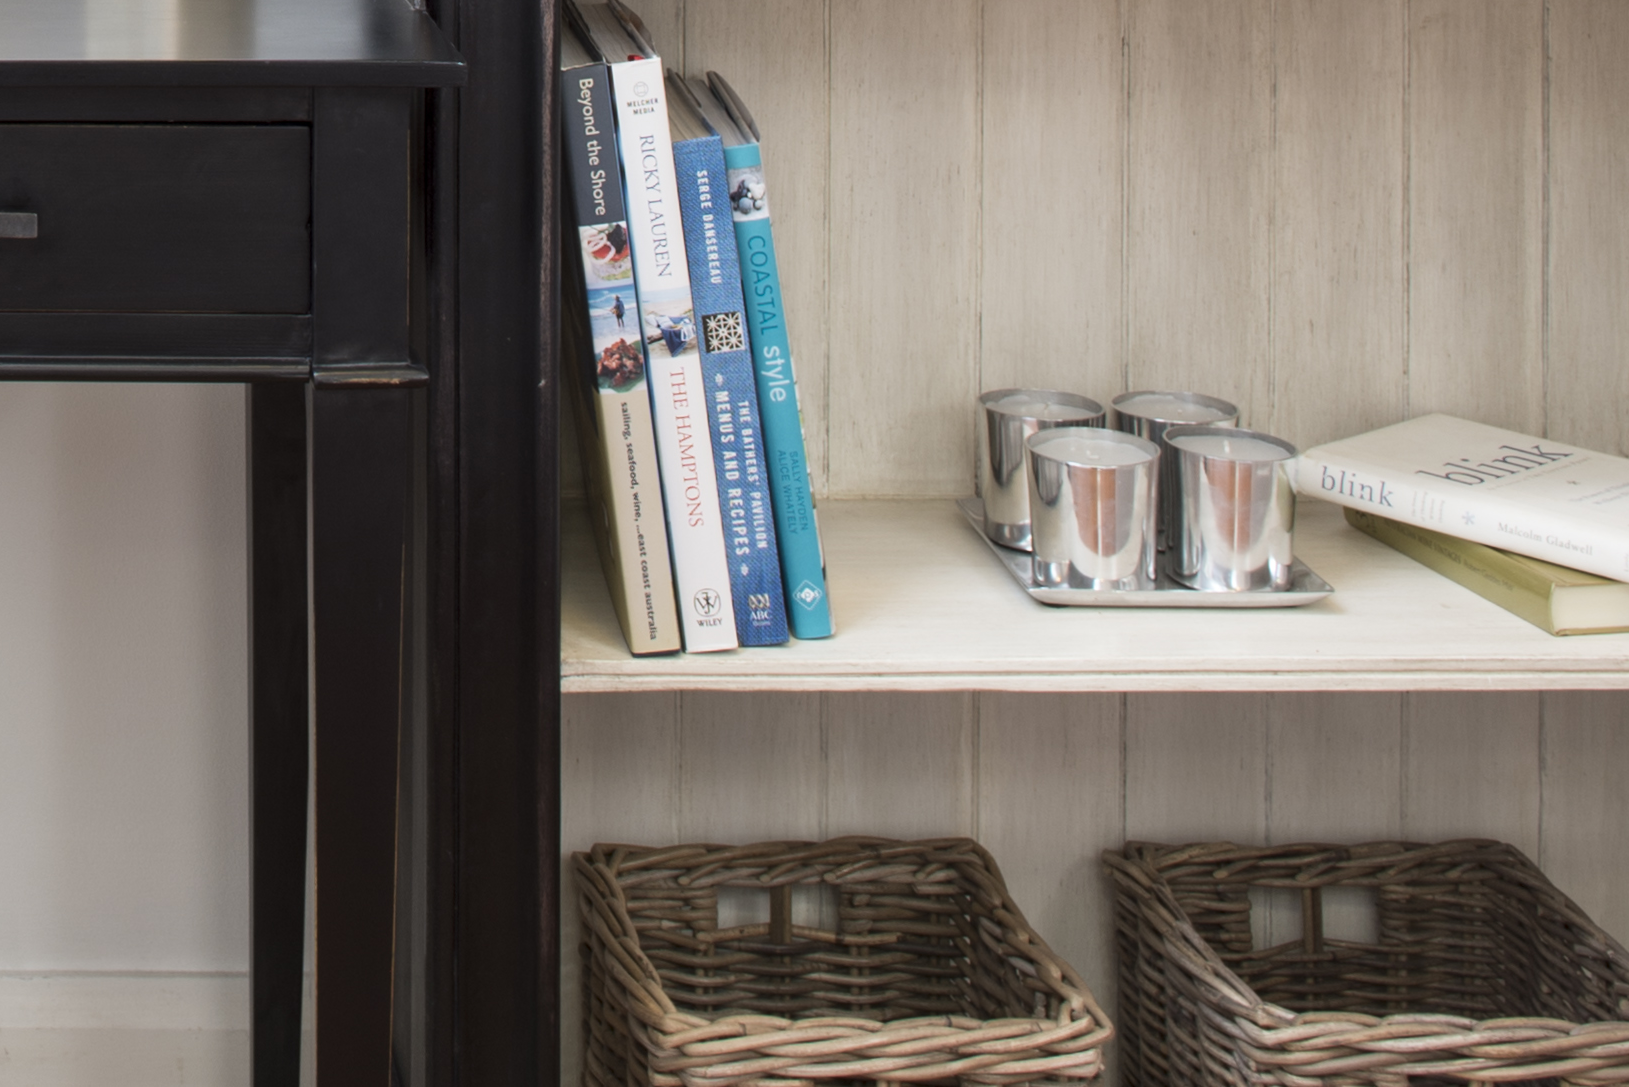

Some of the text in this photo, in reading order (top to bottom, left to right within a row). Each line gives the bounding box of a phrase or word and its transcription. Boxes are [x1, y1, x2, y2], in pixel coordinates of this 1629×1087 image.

[626, 98, 659, 108] MELCHER
[633, 107, 655, 115] MEDIA
[577, 78, 606, 216] Beyond the Shore
[639, 134, 672, 277] RICKY LAUREN
[697, 171, 722, 284] SERGE DANSEREAU
[747, 235, 790, 402] COASTAL style
[621, 401, 632, 440] sailing,
[625, 442, 638, 489] seafood,
[669, 367, 704, 528] THE HAMPTONS
[1415, 444, 1574, 487] blink
[715, 390, 750, 556] MENUS AND RECIPES
[737, 400, 768, 550] THE BATHERS' PAVILION
[777, 449, 798, 534] ALICE WHATELY
[789, 450, 808, 531] SALLY HAYDEN
[1321, 465, 1394, 508] blink
[632, 492, 642, 522] wine,
[1497, 521, 1594, 557] Malcolm Gladwell
[640, 560, 651, 590] coast
[644, 591, 657, 641] australia
[696, 618, 723, 627] WILEY
